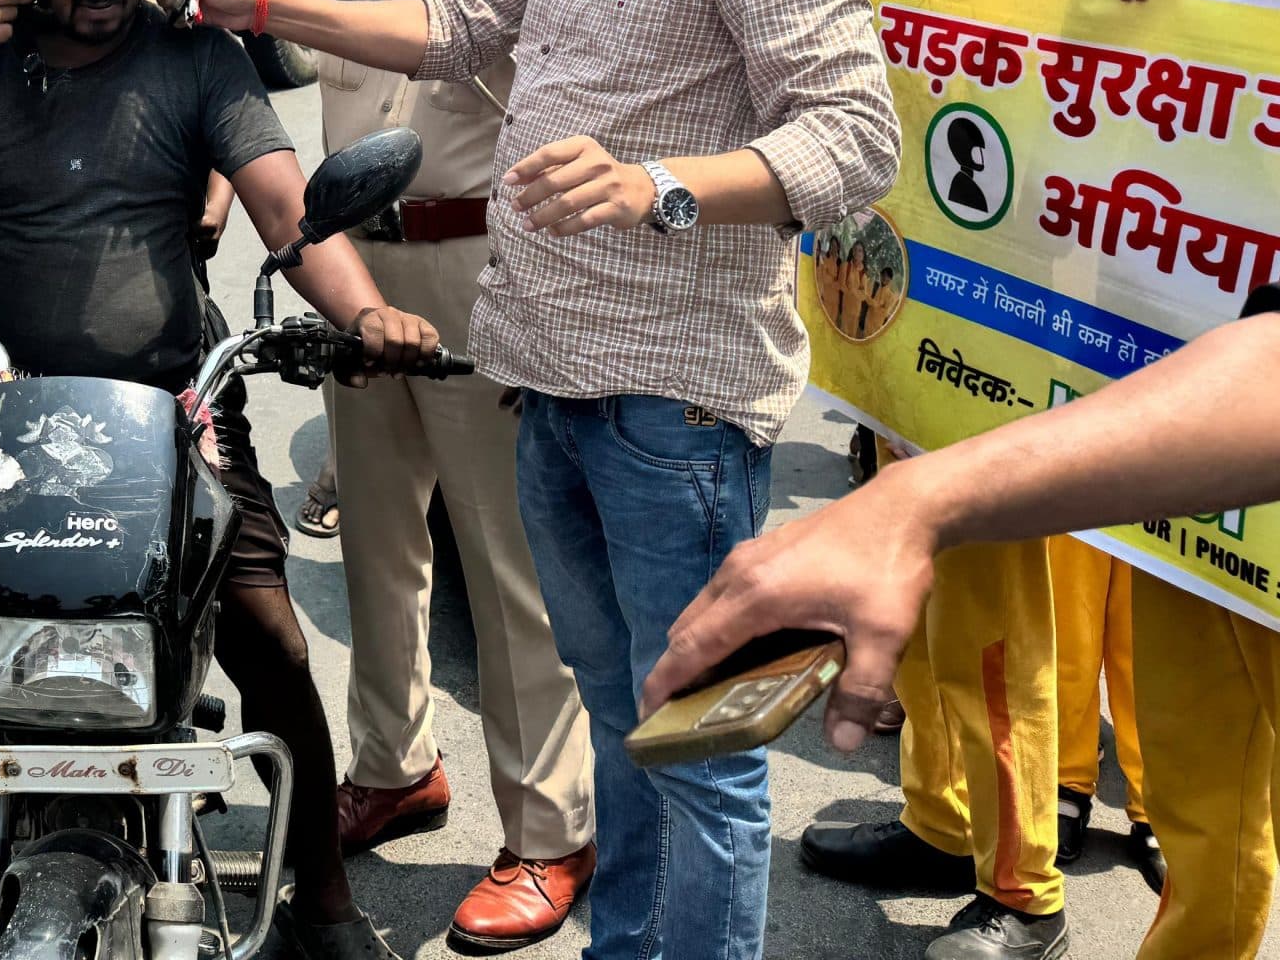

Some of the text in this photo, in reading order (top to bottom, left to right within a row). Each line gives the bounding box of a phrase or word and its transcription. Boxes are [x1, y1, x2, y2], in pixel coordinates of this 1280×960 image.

[880, 6, 1029, 95] सड़क
[1037, 37, 1246, 142] सुरक्षा
[1039, 168, 1280, 294] अभिया
[925, 266, 969, 297] सफर
[972, 276, 989, 305] में
[994, 282, 1047, 327] कितनी
[1052, 308, 1074, 338] भी
[1078, 322, 1113, 353] कम
[1118, 333, 1139, 364] हो
[67, 513, 118, 531] Hero
[1195, 535, 1270, 593] PHONE
[27, 760, 108, 778] Mata
[153, 757, 195, 778] Di
